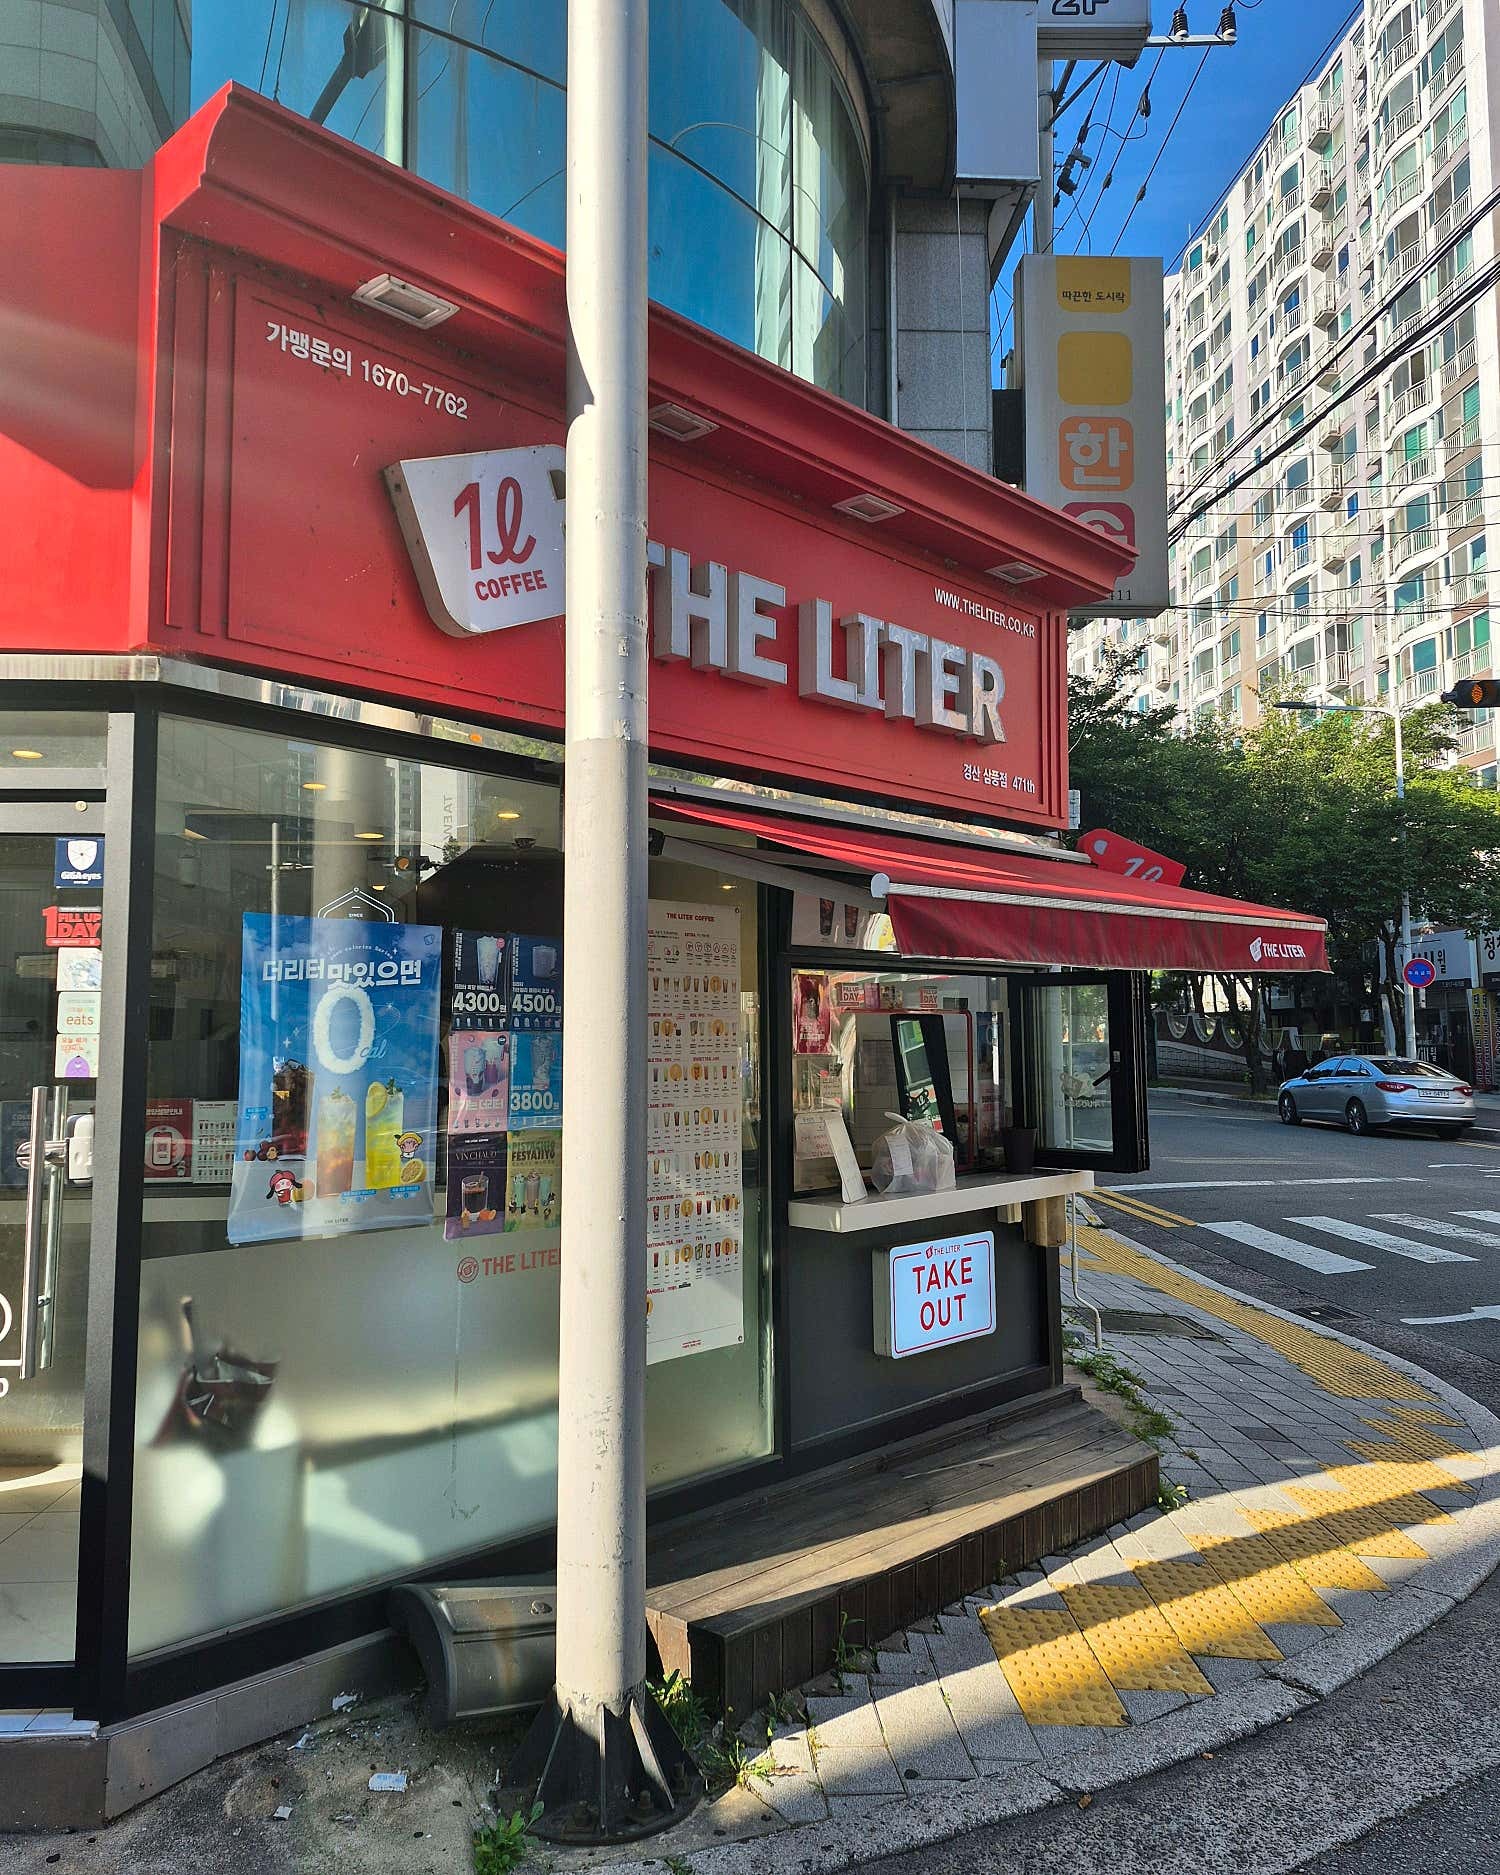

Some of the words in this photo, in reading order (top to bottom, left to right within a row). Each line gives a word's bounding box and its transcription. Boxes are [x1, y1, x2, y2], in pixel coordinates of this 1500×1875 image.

[1062, 290, 1092, 302] 따끈한
[1095, 291, 1126, 304] 도시락
[267, 322, 352, 376] 가맹문의
[361, 359, 468, 419] 1670-7762
[475, 569, 547, 601] COFFEE
[934, 587, 1035, 638] WWW.THELITER.CO.KR
[648, 541, 787, 688] HE
[800, 597, 1007, 746] LITER
[963, 763, 980, 781] 경산
[983, 766, 1008, 788] 삼풍점
[1012, 775, 1035, 794] 471th
[57, 922, 102, 938] DAY
[83, 913, 102, 922] UP
[1262, 942, 1279, 958] THE
[1279, 943, 1306, 958] LITER
[66, 1015, 94, 1025] eats
[482, 1255, 515, 1276] THE
[520, 1247, 561, 1271] LITE
[934, 1247, 944, 1256] THE
[945, 1244, 961, 1254] LITER
[912, 1256, 973, 1294] TAKE
[920, 1293, 966, 1331] OUT
